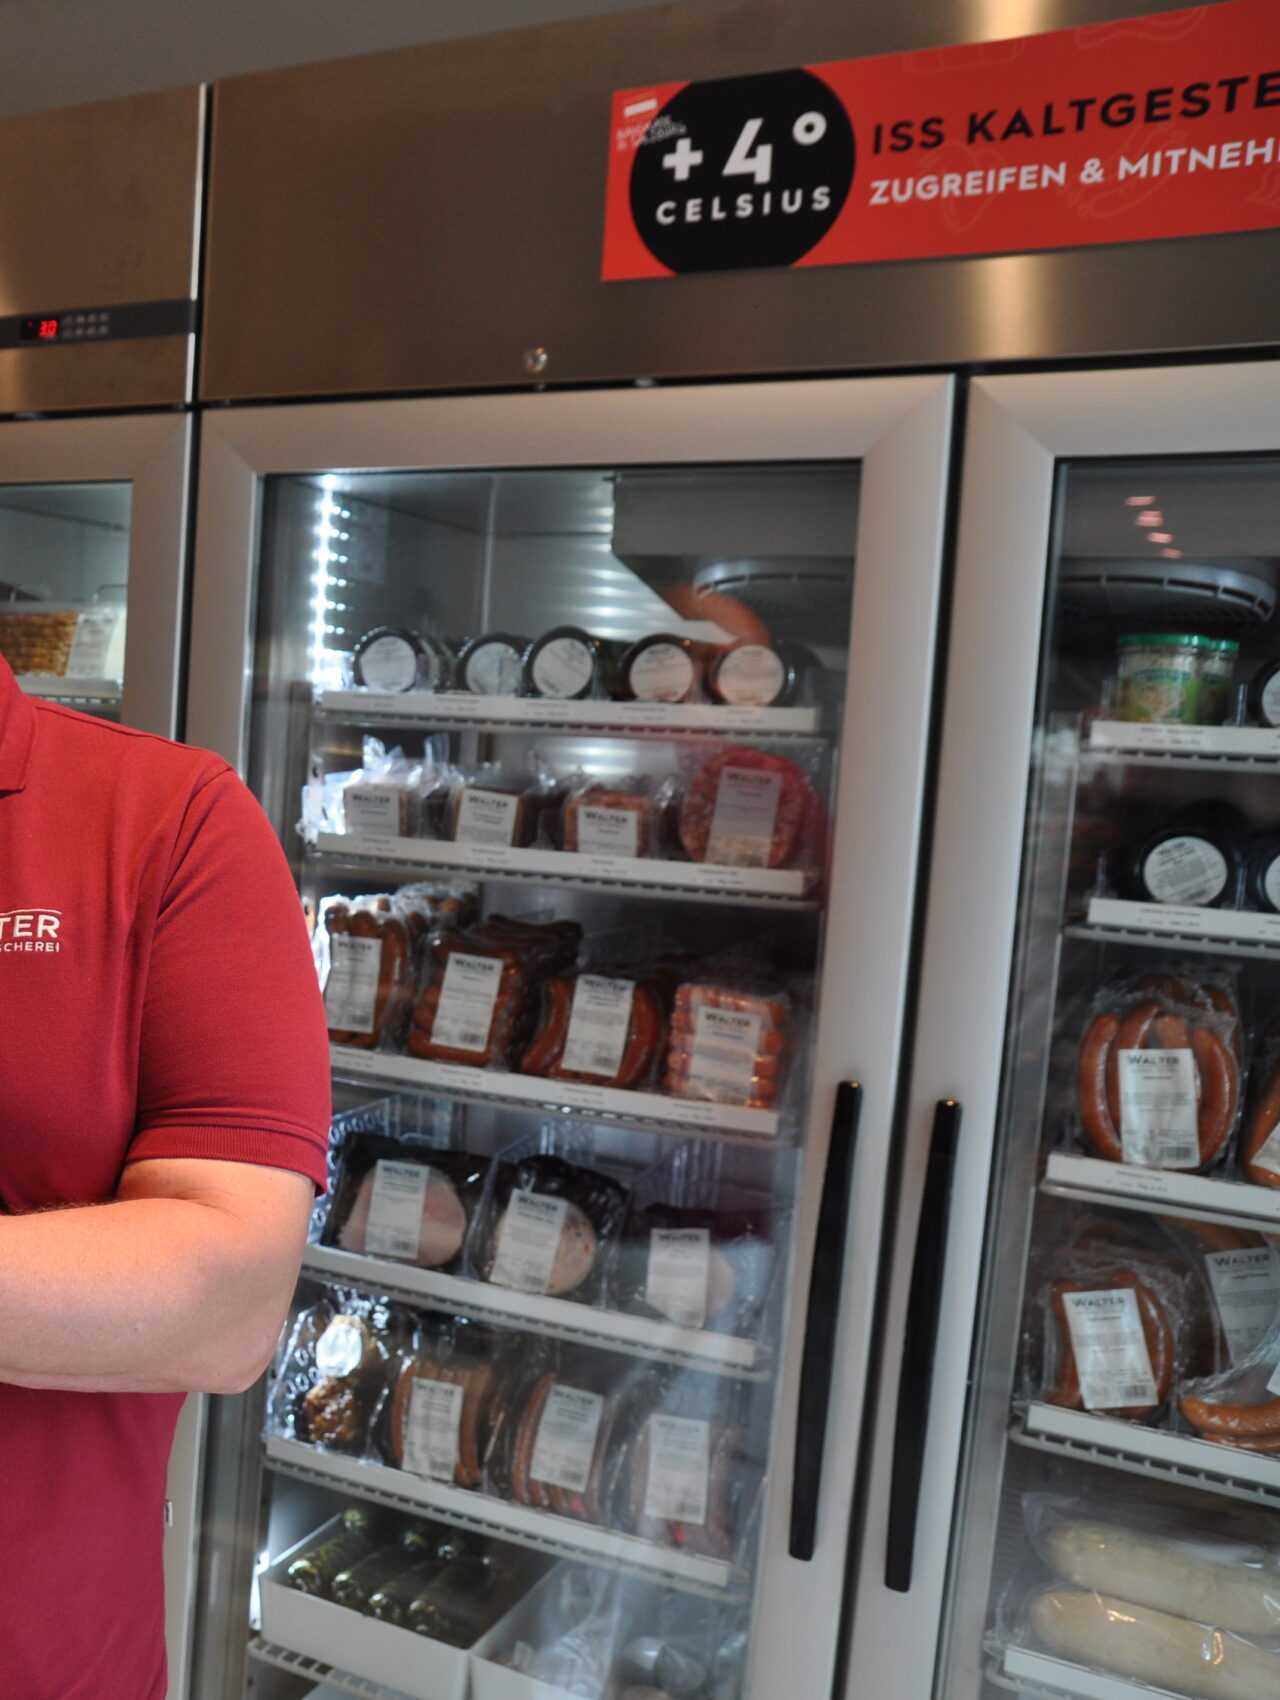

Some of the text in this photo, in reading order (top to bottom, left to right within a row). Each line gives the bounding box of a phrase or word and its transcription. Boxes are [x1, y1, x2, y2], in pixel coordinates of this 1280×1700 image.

[873, 71, 1280, 154] ISS KALTGESTE
[868, 136, 1280, 206] ZUGREIFEN & MITNEH
[656, 186, 831, 226] CELSIUS
[584, 811, 628, 823] WALTER
[704, 1011, 751, 1027] WALTER
[1127, 1054, 1179, 1065] WALTER
